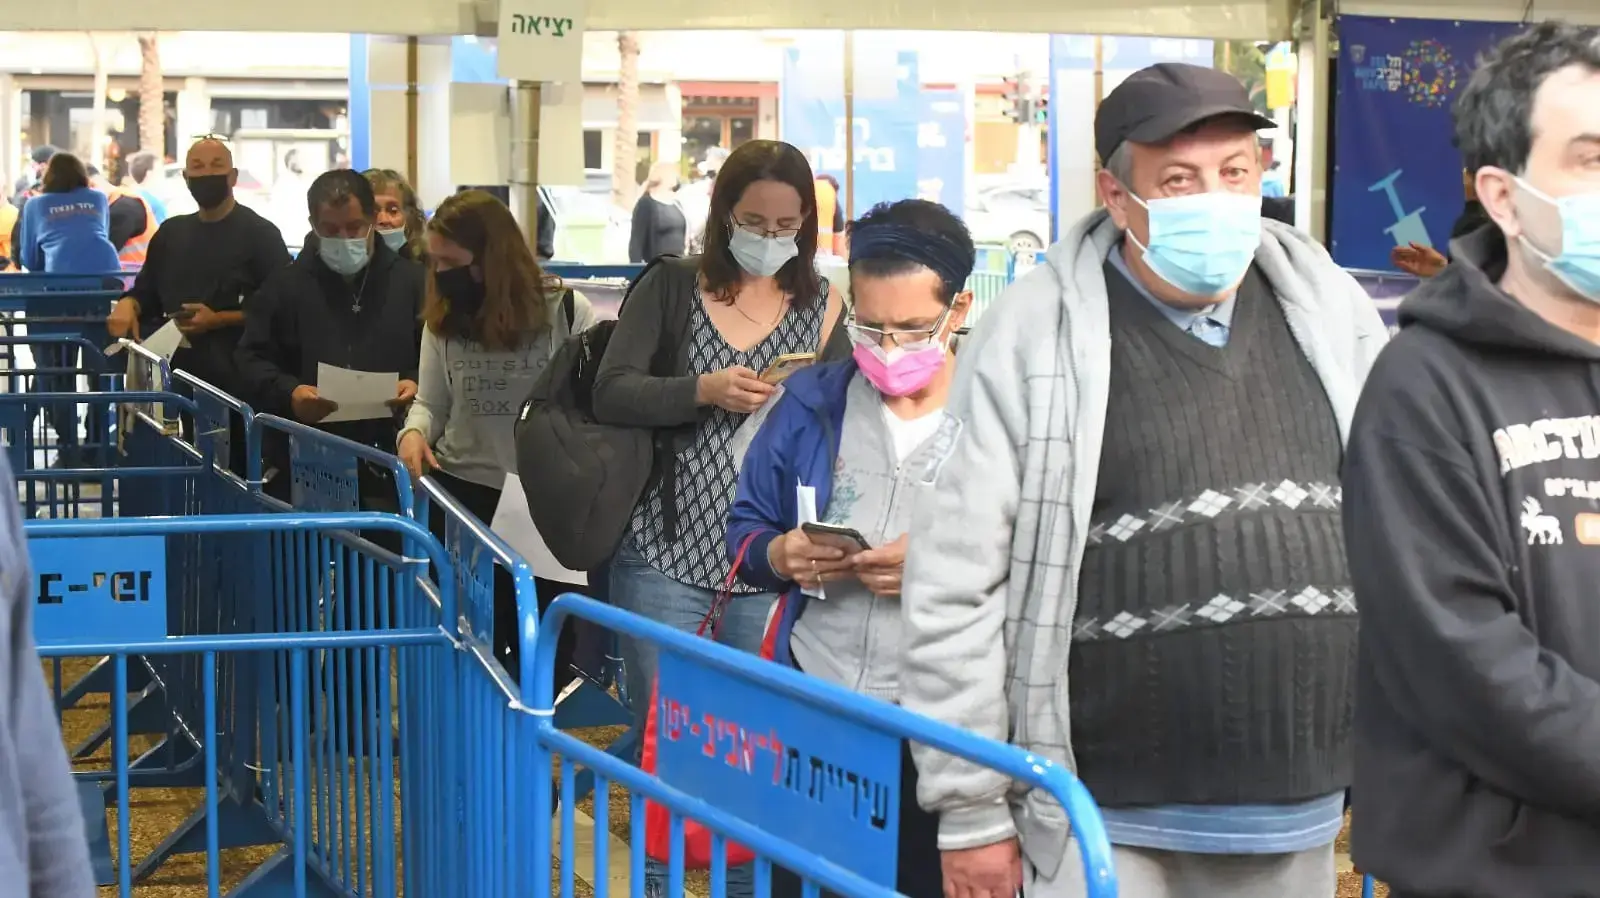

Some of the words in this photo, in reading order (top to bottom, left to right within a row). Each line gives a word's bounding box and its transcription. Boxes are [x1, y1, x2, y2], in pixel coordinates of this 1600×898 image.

[512, 13, 573, 37] יציאה
[463, 374, 507, 392] The
[1493, 414, 1600, 478] ARCTI
[809, 755, 889, 830] עיריית
